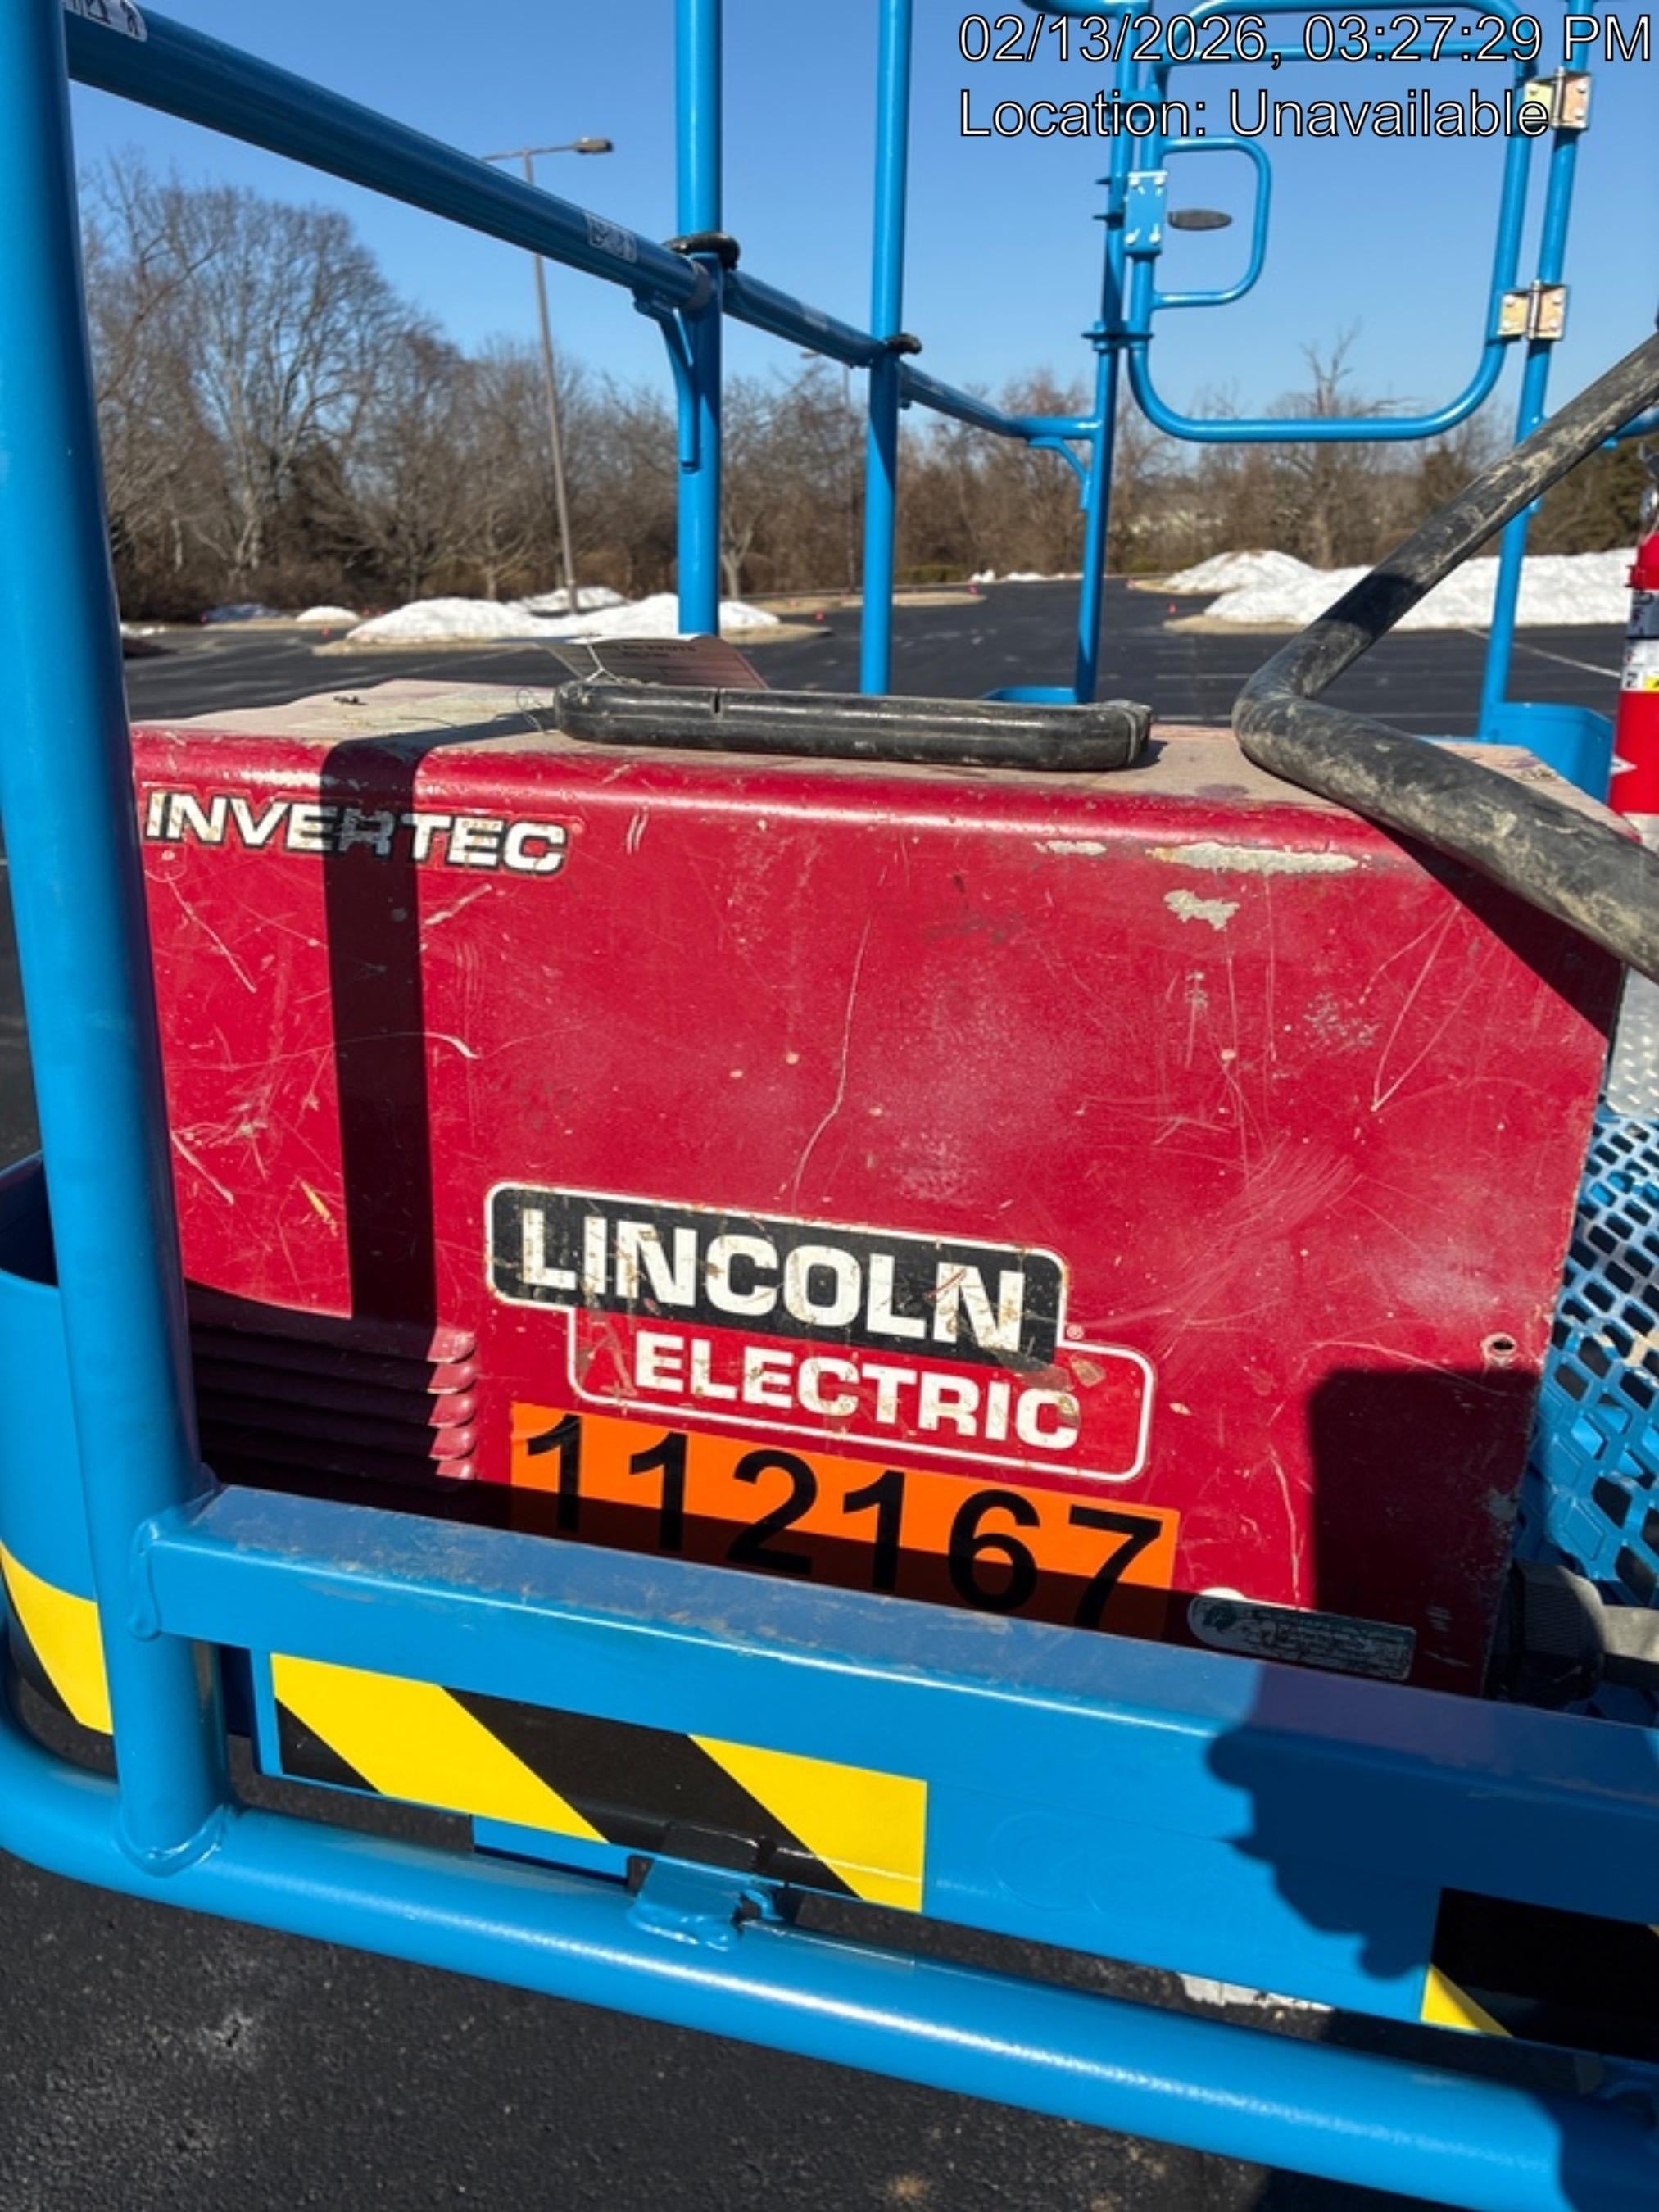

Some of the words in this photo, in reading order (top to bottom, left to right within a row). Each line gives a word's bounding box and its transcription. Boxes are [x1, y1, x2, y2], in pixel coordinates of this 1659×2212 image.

[144, 791, 569, 874] INVERTEC
[521, 1208, 1026, 1352] LINCOLN
[634, 1330, 1081, 1448] ELECTRIC
[526, 1414, 1163, 1629] 112167
